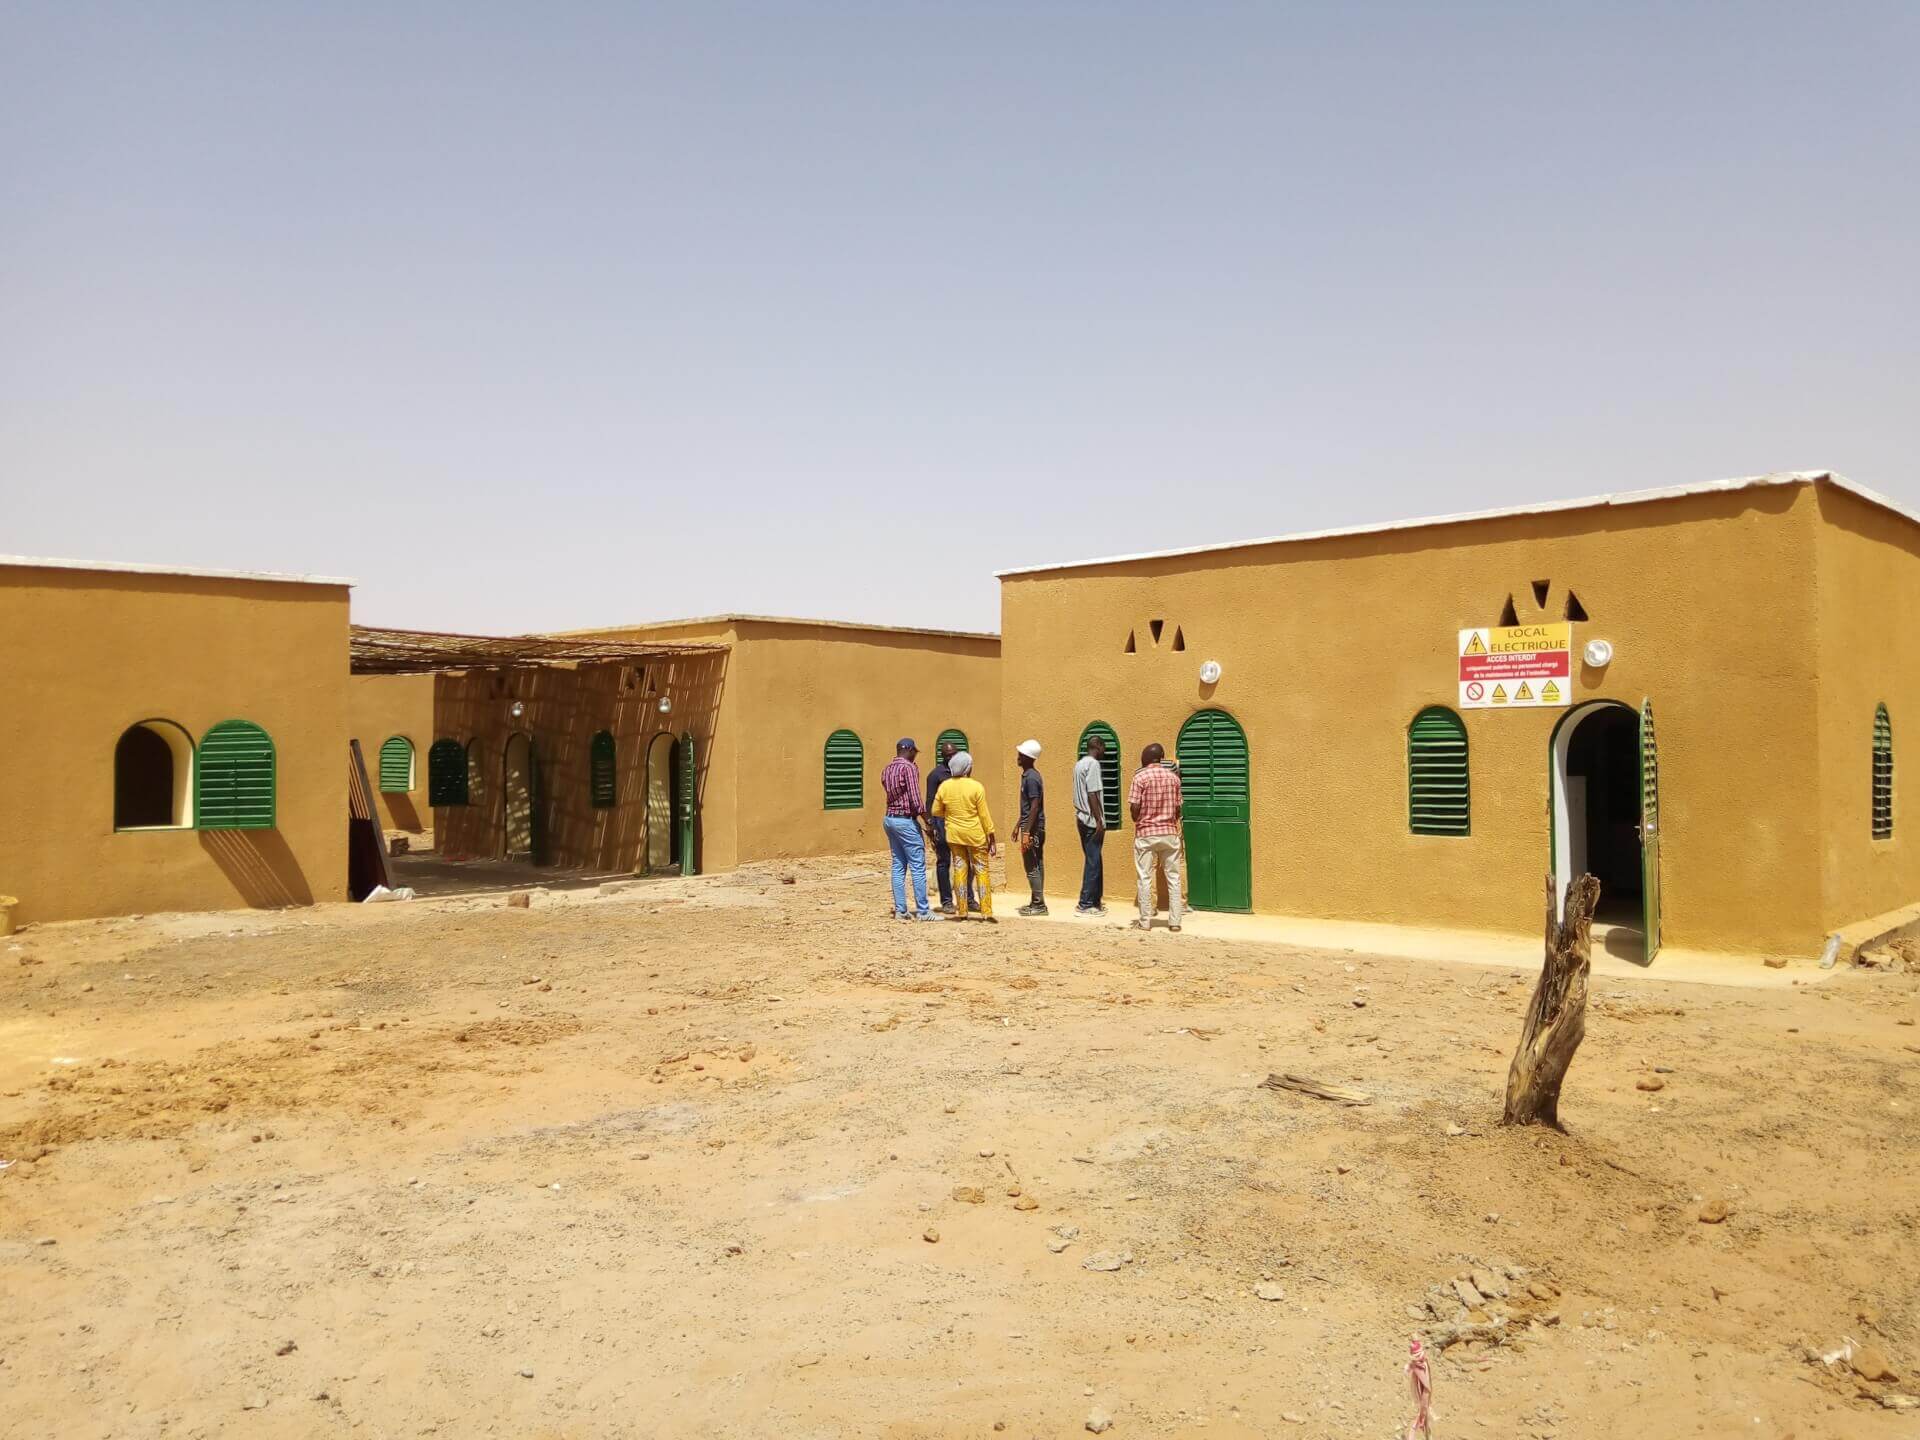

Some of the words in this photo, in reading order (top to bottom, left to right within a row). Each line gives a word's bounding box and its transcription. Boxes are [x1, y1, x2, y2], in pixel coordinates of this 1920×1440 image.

[1508, 628, 1548, 638] LOCAL
[1490, 640, 1566, 653] ELECTRIQUE
[1508, 653, 1537, 662] INTERDIT
